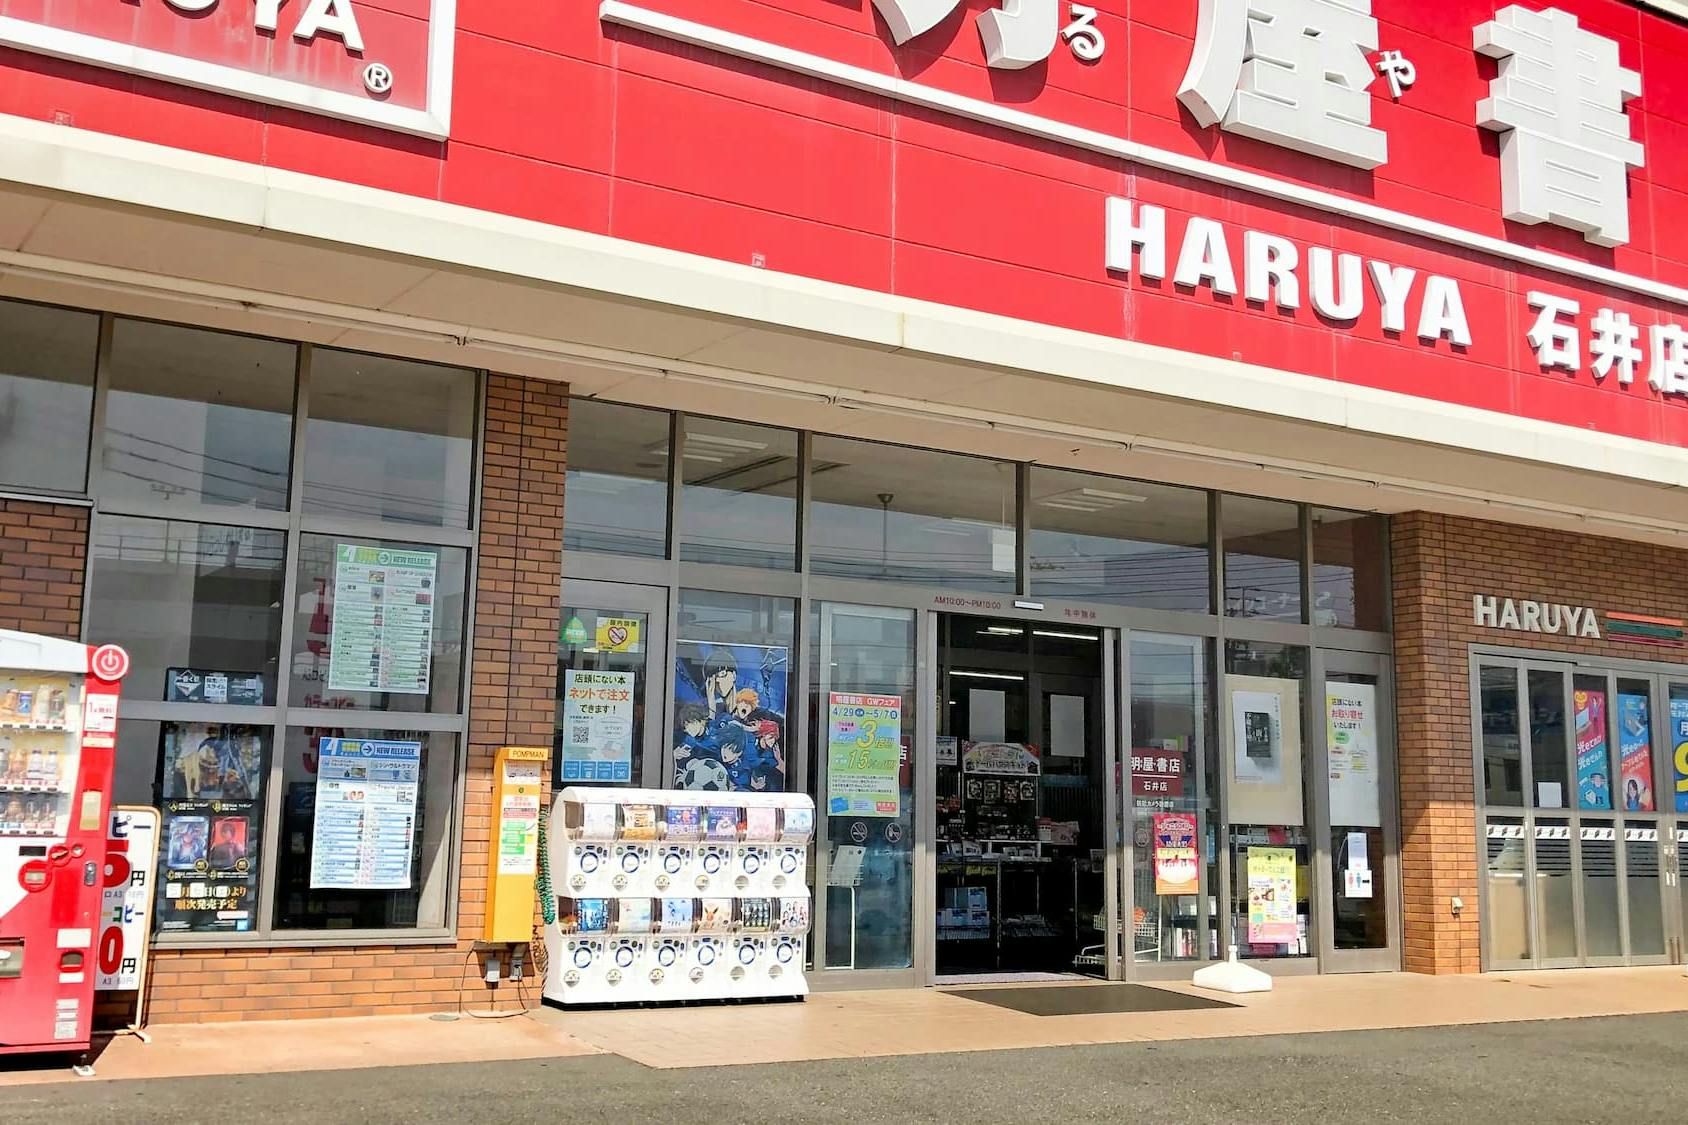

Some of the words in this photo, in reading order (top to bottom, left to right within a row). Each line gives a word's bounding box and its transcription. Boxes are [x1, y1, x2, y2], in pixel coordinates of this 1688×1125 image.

[1061, 4, 1106, 60] る
[1375, 49, 1416, 99] や
[1104, 195, 1473, 348] HARUYA
[1526, 290, 1688, 401] 石井店
[1473, 594, 1601, 639] HARUYA
[574, 673, 627, 685] 店頭にない本
[569, 687, 630, 702] ネットで注文
[1331, 709, 1364, 720] お取り寄せ
[376, 747, 391, 755] NEW
[391, 747, 415, 756] RELEASE
[512, 750, 544, 759] POMPMAN
[1143, 781, 1168, 791] 石井店
[174, 898, 238, 910] 順次発売予定
